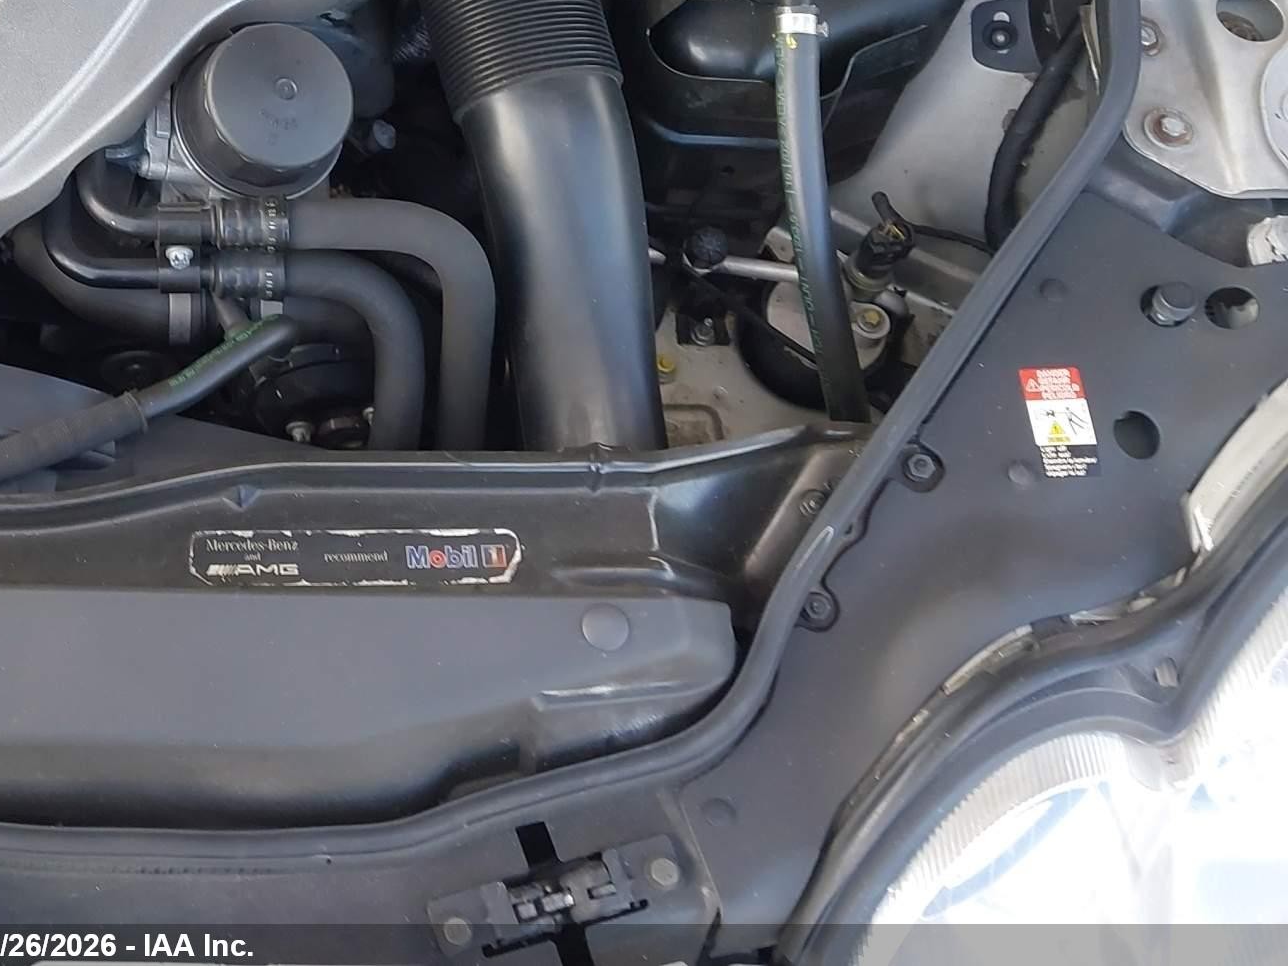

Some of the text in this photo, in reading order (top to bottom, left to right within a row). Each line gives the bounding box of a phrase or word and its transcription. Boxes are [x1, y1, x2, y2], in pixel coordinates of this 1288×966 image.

[206, 538, 299, 552] Mercedes-Benz
[234, 563, 300, 576] AMG
[324, 550, 389, 563] recommend
[405, 544, 478, 569] Mobil
